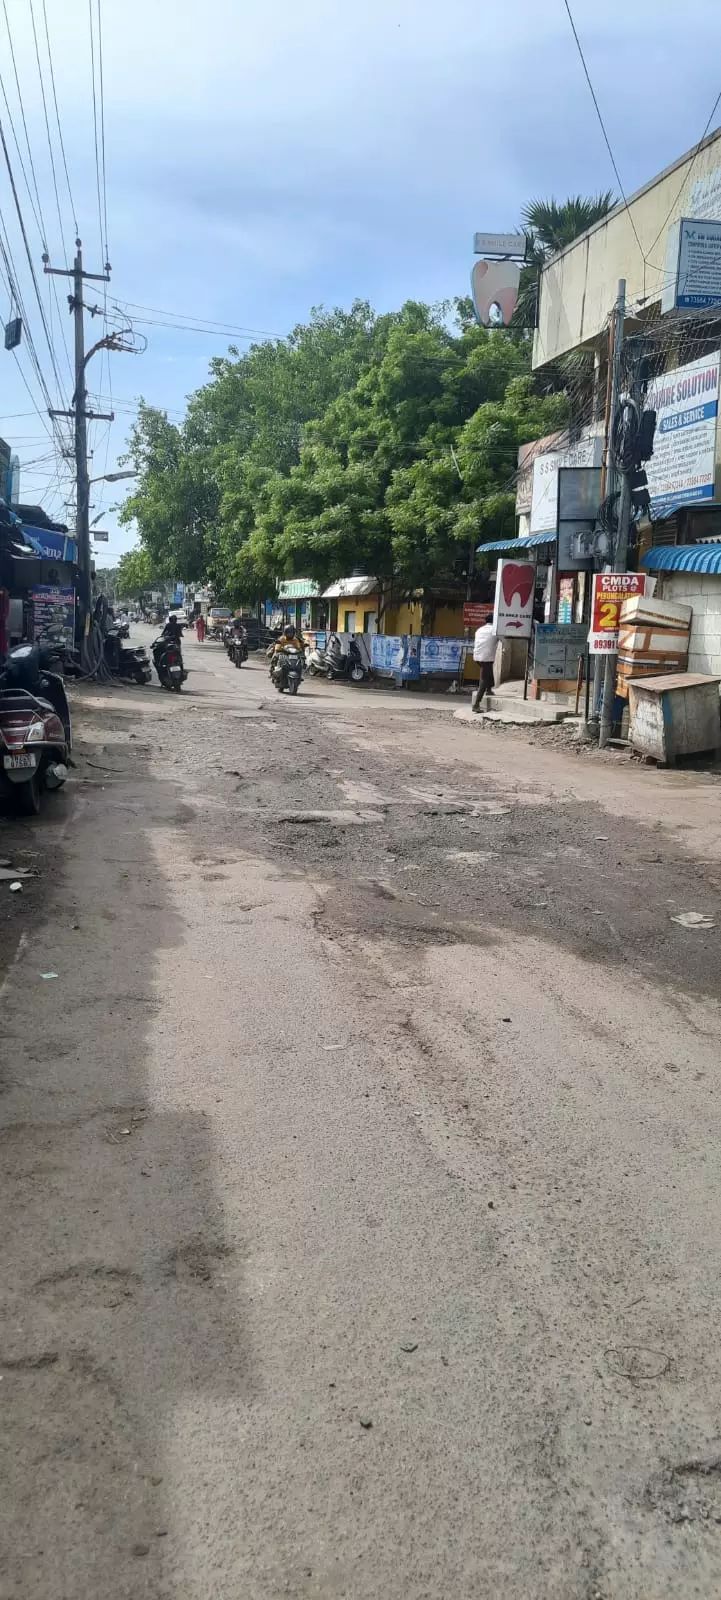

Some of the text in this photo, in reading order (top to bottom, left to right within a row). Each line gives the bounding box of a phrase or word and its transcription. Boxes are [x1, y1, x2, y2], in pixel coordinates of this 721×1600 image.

[676, 367, 718, 402] SOLUTION
[662, 406, 705, 430] SALES & SERVICE
[540, 463, 544, 476] S
[545, 462, 549, 474] S
[601, 576, 639, 586] CMDA
[602, 584, 628, 592] PLOTS
